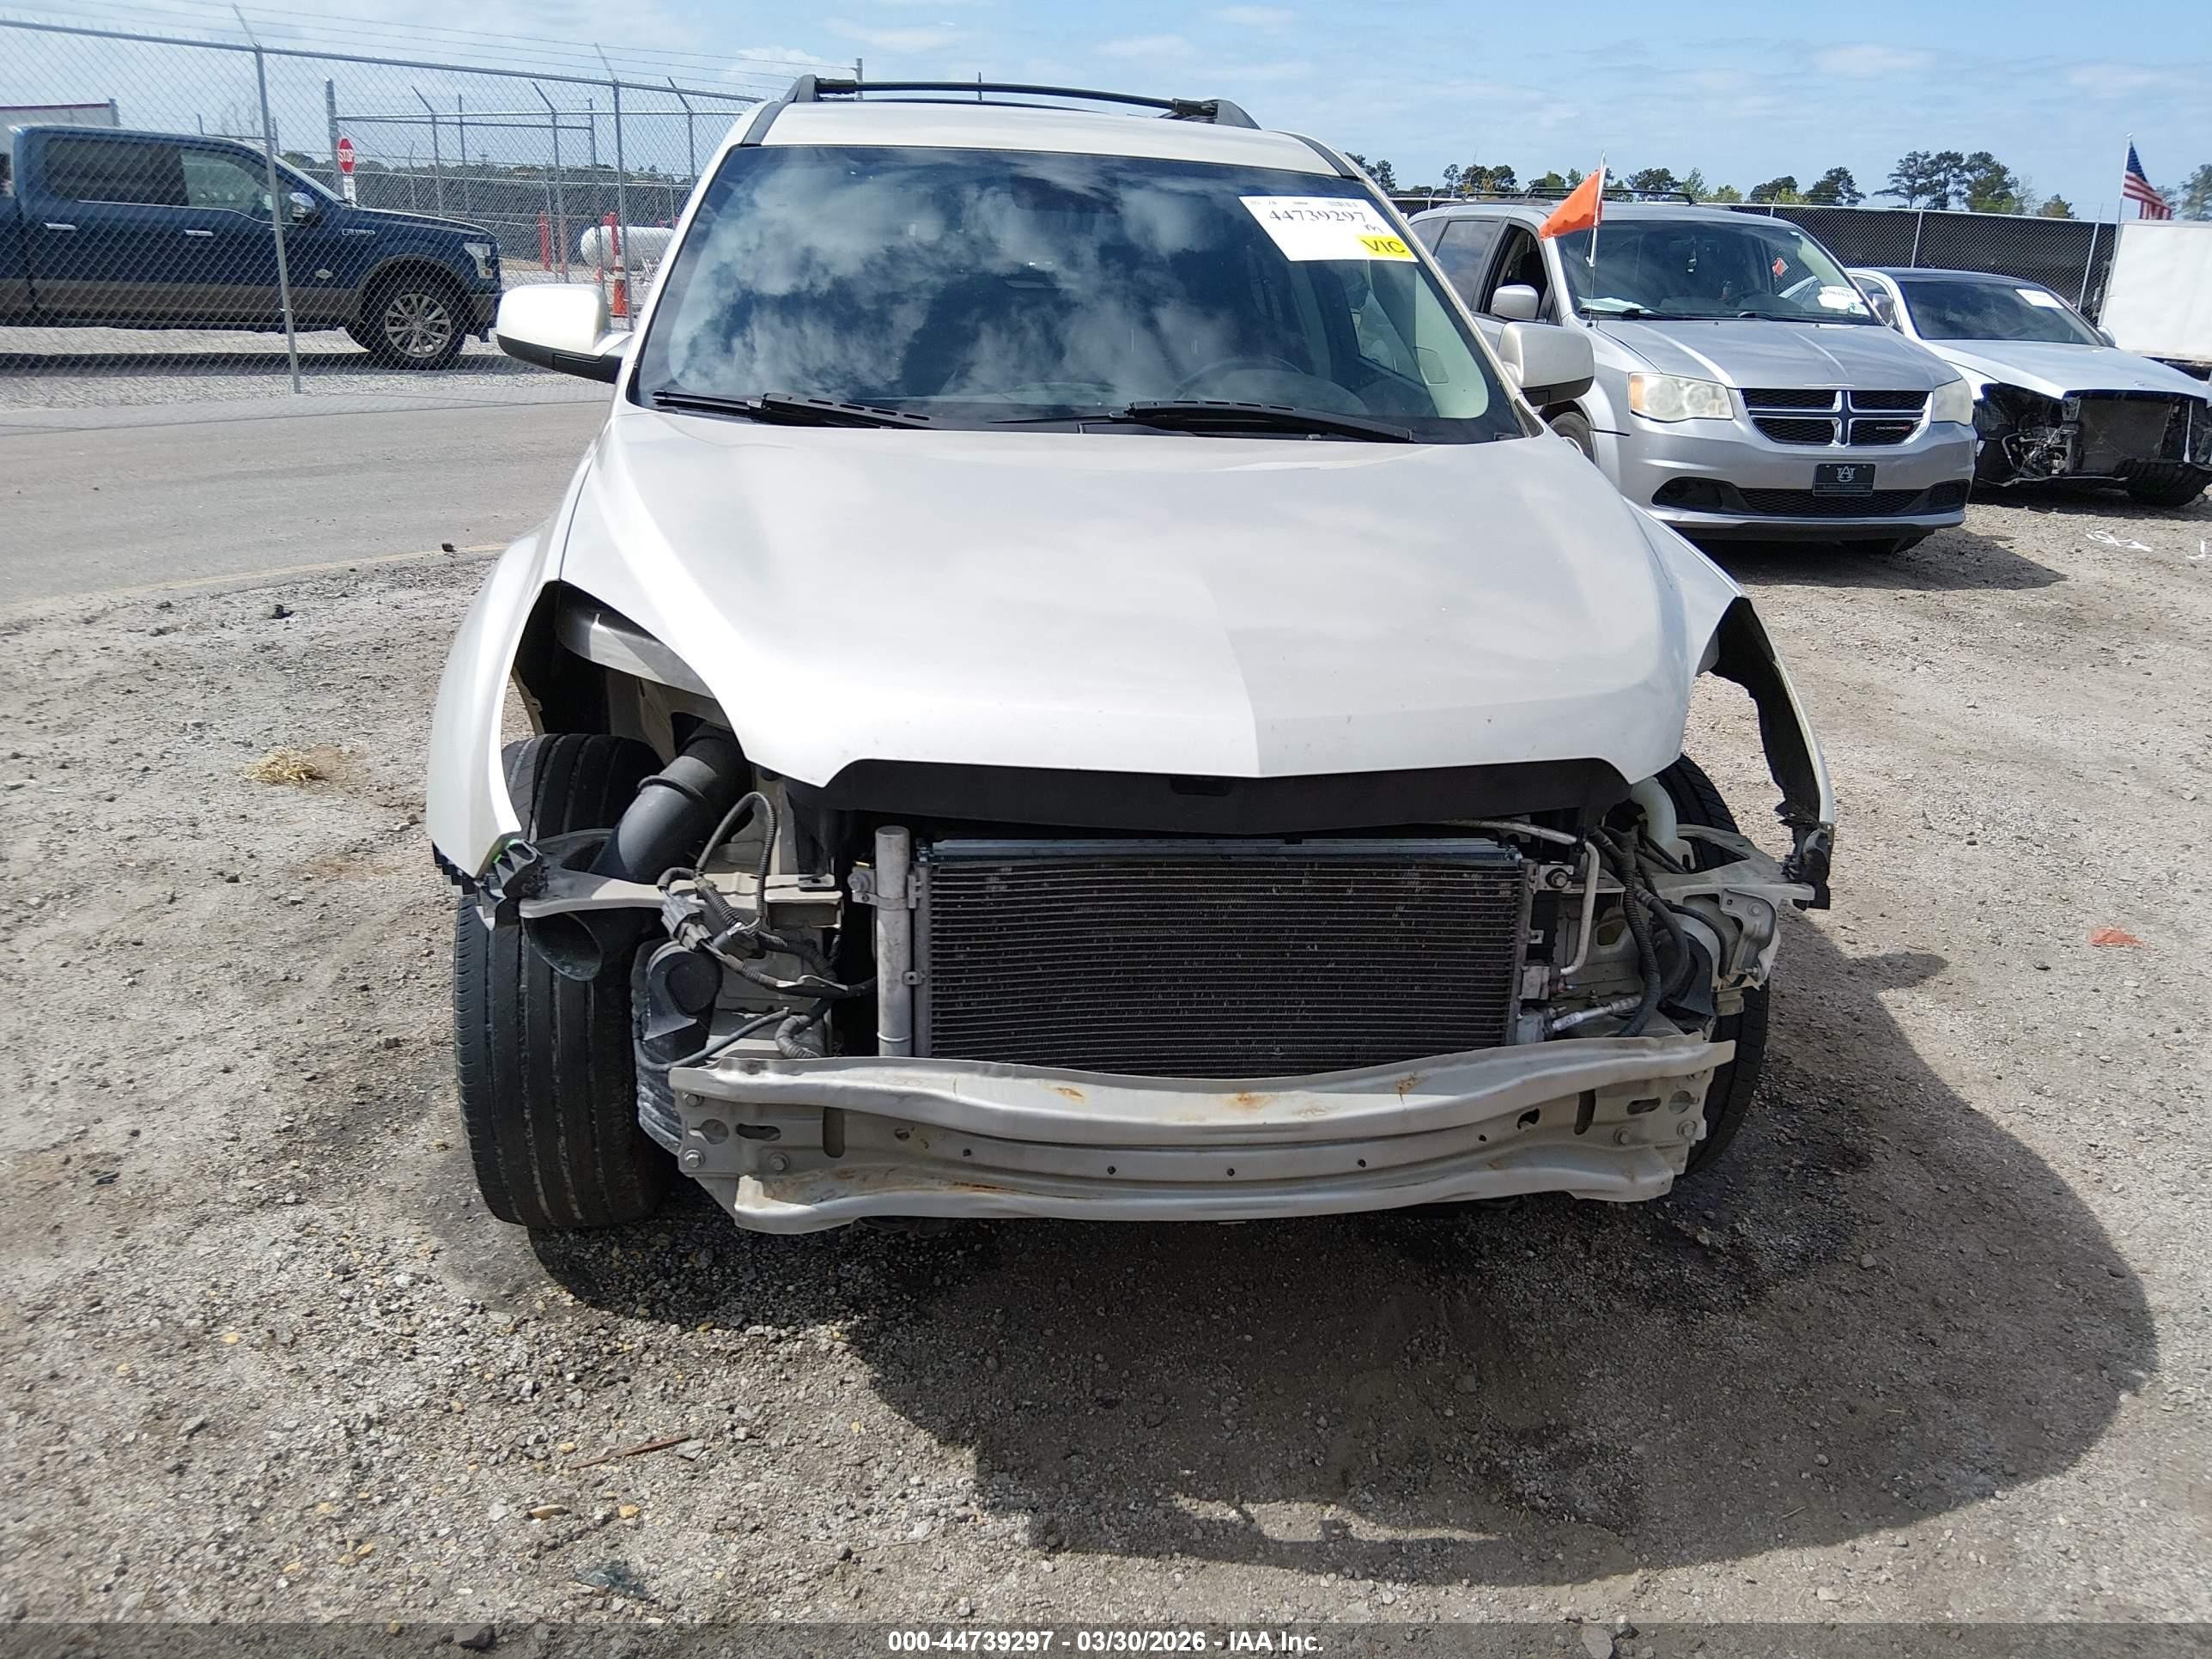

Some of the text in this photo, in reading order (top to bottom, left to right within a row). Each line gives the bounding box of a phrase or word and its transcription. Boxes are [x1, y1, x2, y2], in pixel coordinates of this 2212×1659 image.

[338, 149, 355, 163] STOP
[1269, 210, 1365, 222] 44739297
[1362, 240, 1406, 254] VIC
